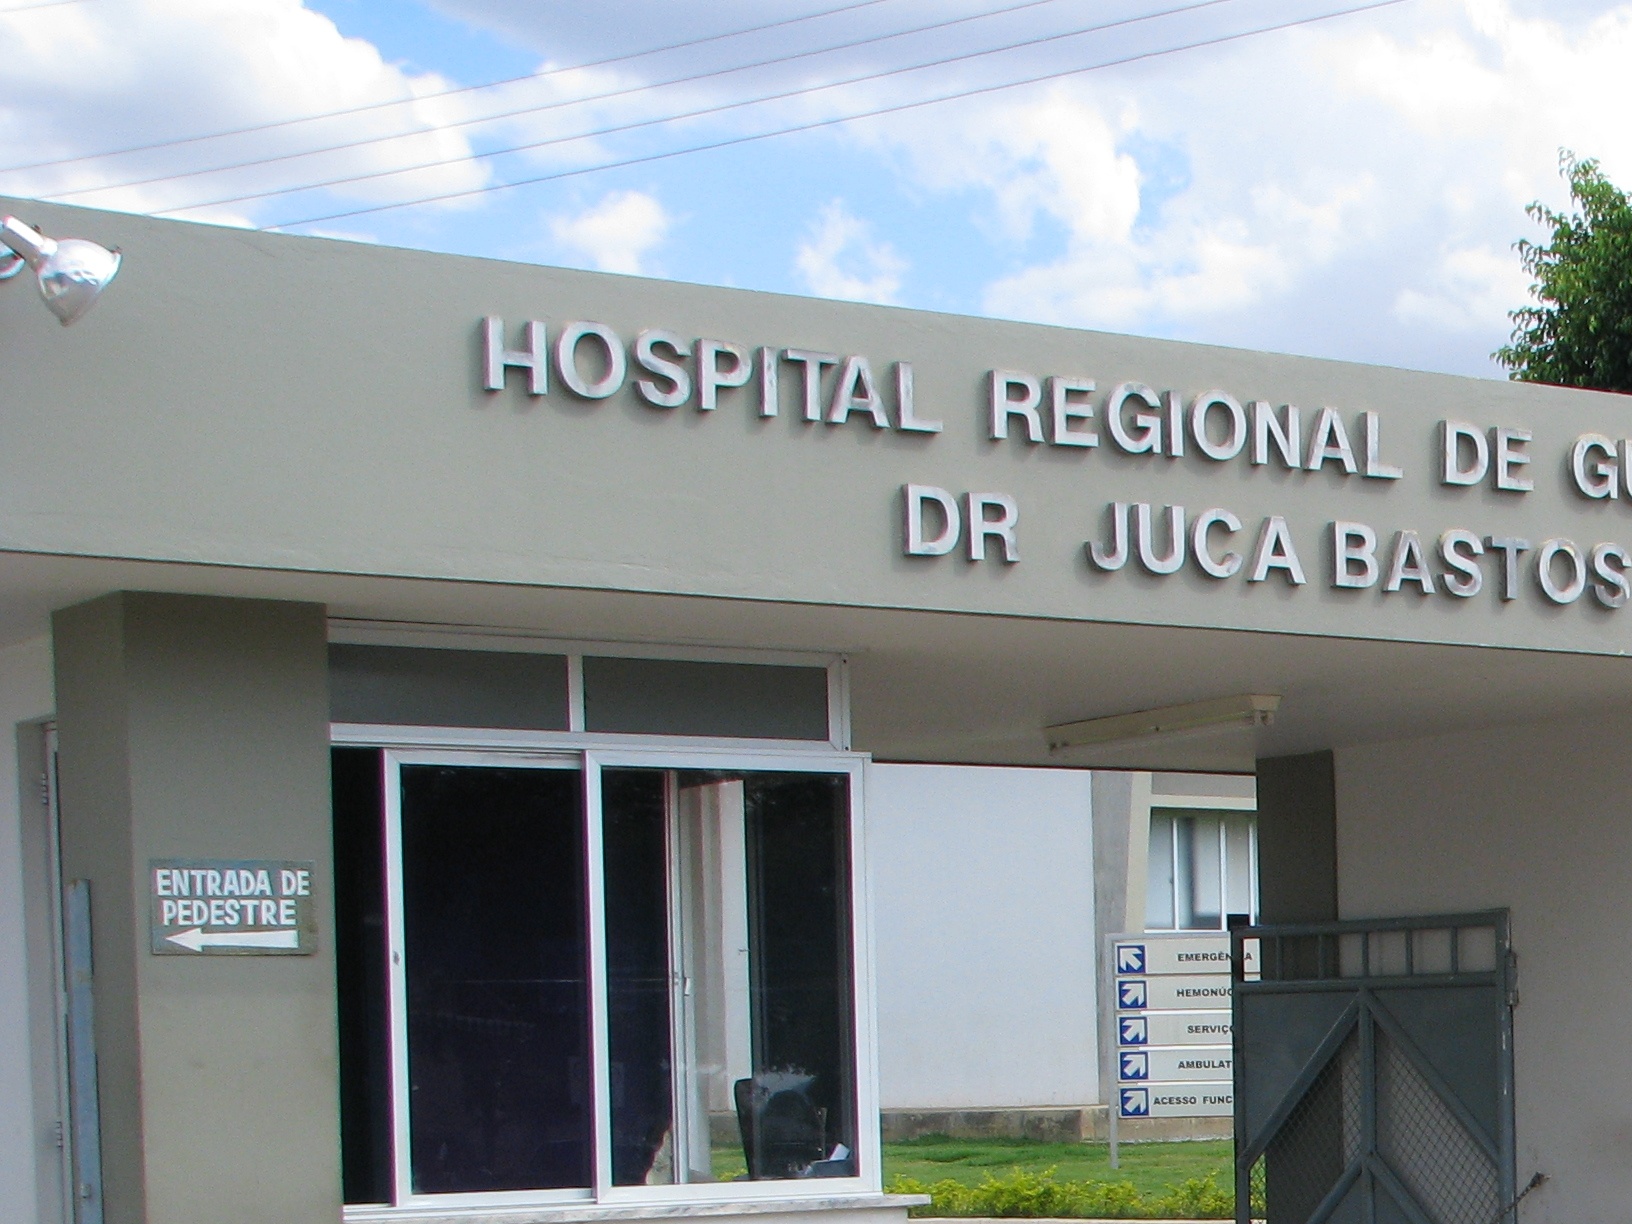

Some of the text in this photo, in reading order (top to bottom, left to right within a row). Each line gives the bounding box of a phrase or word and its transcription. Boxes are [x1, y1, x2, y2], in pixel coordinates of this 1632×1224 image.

[481, 315, 943, 434] HOSPITAL
[988, 368, 1403, 479] REGIONAL
[1440, 418, 1535, 493] DE
[903, 482, 1632, 610] DR JUCA BASTOS
[155, 868, 311, 897] ENTRADA DE
[162, 898, 297, 926] PEDESTRE
[1177, 951, 1253, 962] EMERGÊNA
[1153, 1096, 1198, 1105] ACESSO
